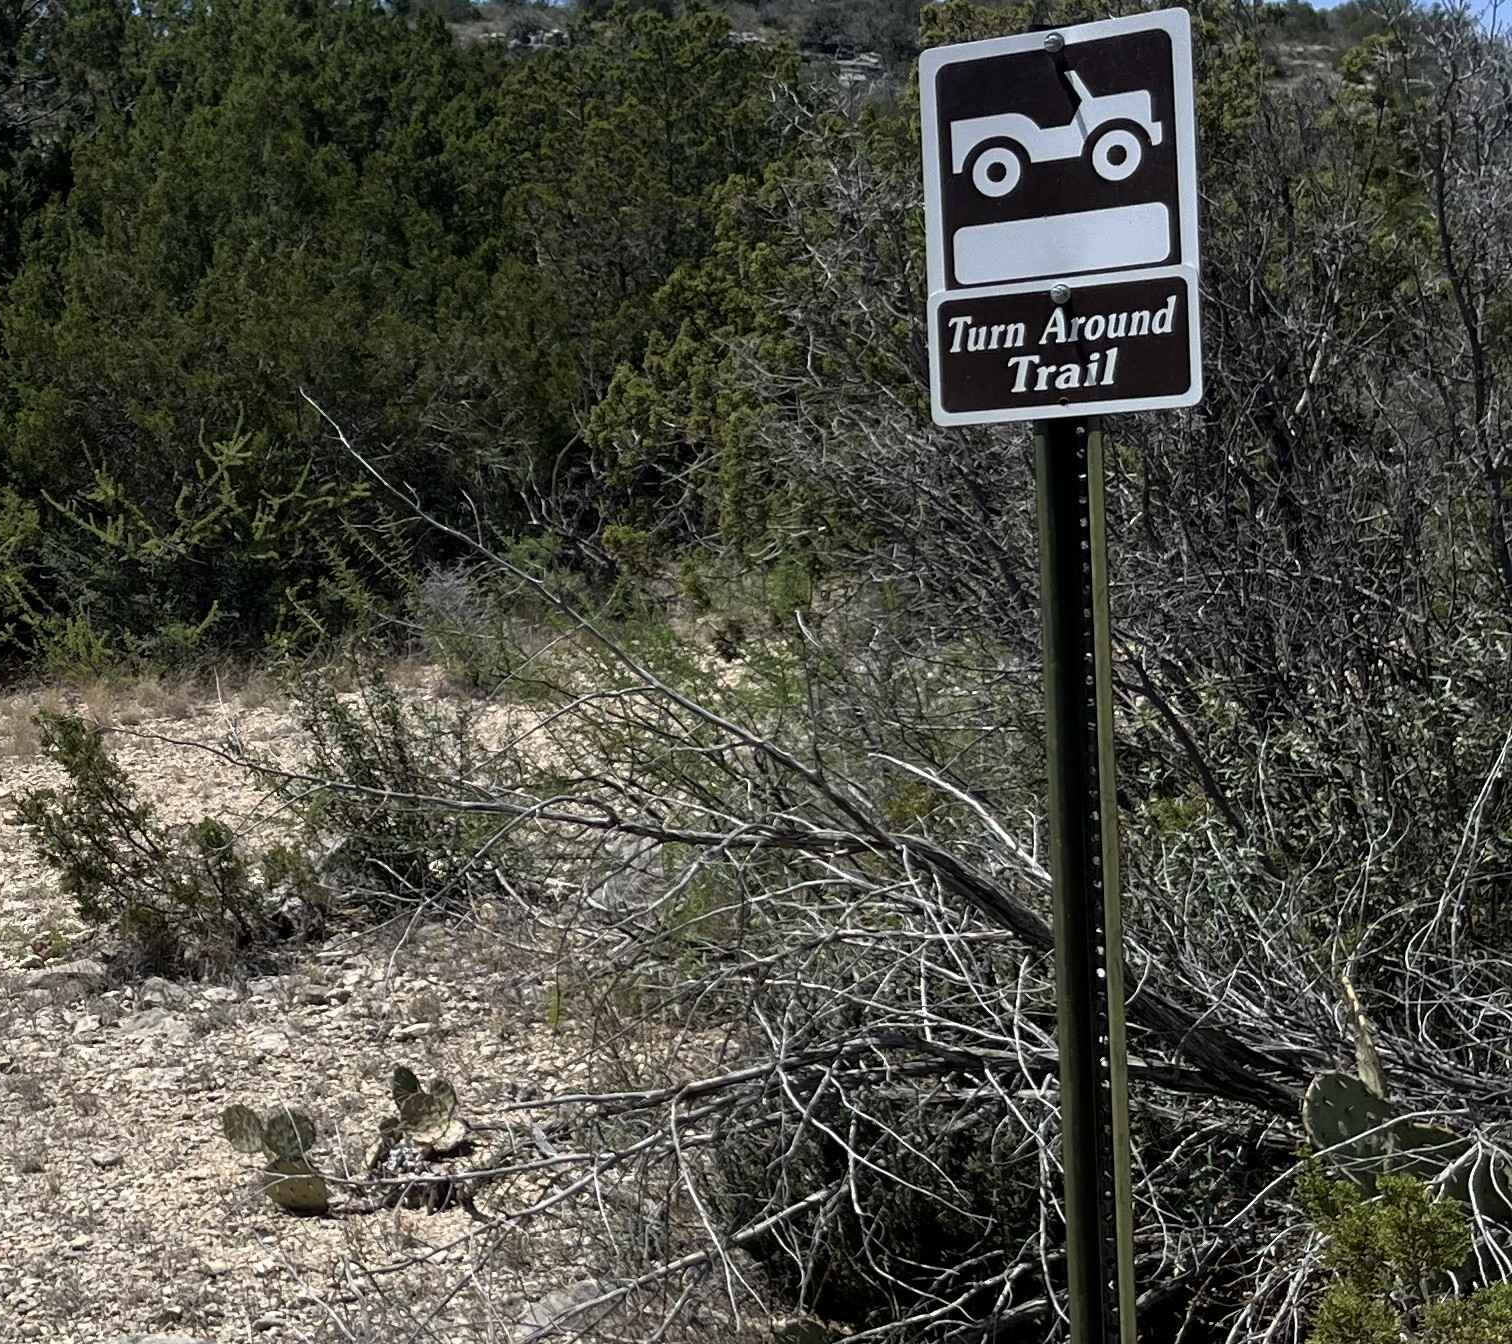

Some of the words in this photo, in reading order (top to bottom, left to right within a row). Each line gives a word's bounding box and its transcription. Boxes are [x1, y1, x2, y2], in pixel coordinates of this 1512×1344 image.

[948, 316, 1026, 354] Turn
[1038, 295, 1177, 346] Around
[1007, 347, 1119, 393] Trail
